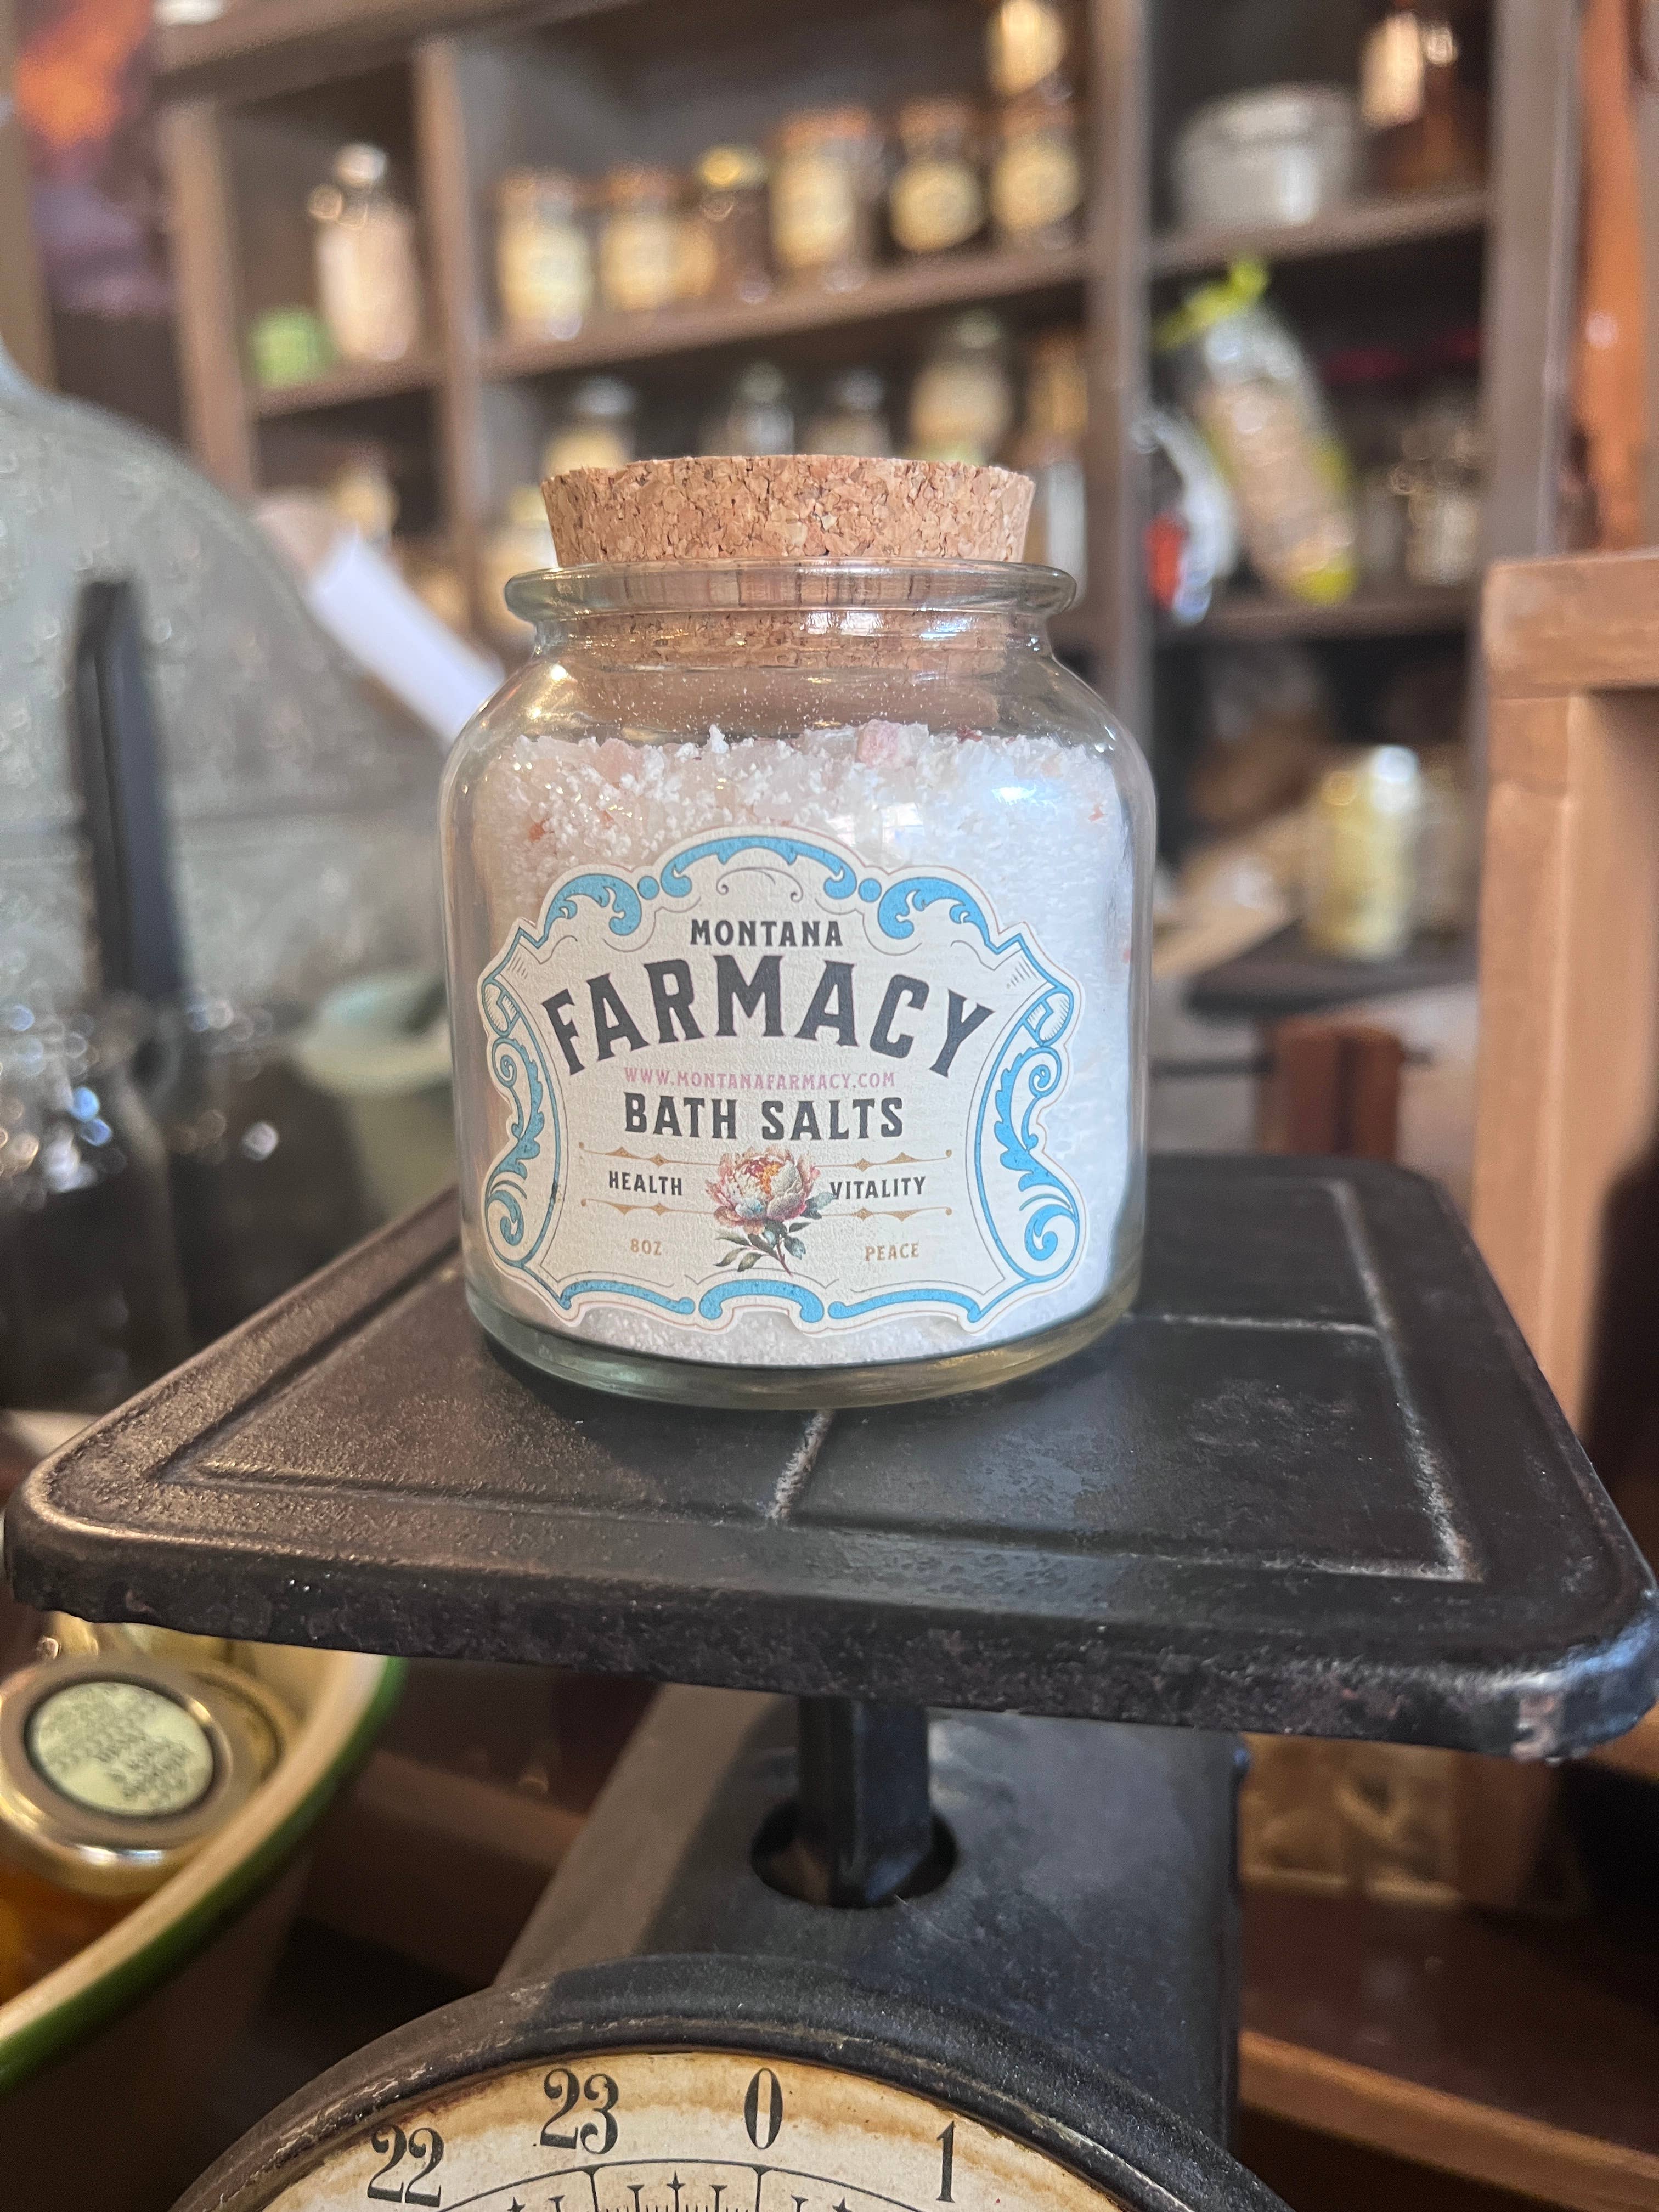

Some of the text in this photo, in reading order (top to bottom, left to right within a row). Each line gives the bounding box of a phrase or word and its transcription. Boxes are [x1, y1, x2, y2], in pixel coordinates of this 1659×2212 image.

[690, 920, 843, 946] MONTANA
[541, 955, 995, 1078] FARMACY
[625, 1067, 895, 1089] WWW.MONTANAFARMACY.COM
[624, 1092, 903, 1141] BATH SALTS
[608, 1171, 682, 1196] HEALTH
[831, 1177, 926, 1200] VITALITY
[866, 1242, 919, 1261] PEACE
[540, 2068, 619, 2154] 23
[744, 2068, 783, 2149] 0
[367, 2125, 445, 2207] 22
[936, 2121, 956, 2202] 1
